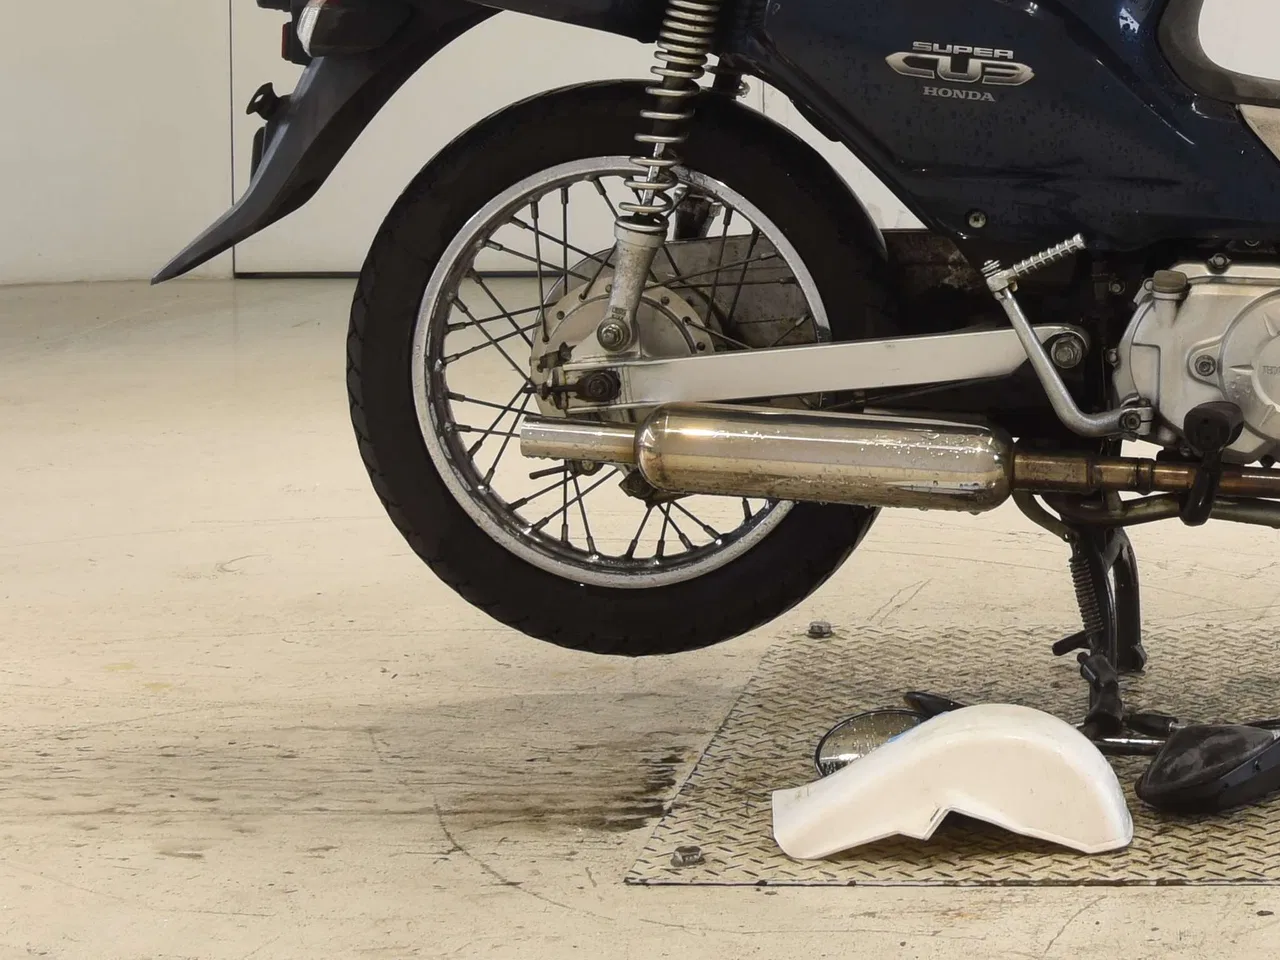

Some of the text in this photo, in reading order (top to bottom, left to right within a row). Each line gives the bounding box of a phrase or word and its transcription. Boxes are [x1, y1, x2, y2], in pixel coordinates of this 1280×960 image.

[912, 41, 1014, 60] SUPER
[885, 51, 1035, 86] CUB
[923, 86, 995, 102] HONDA
